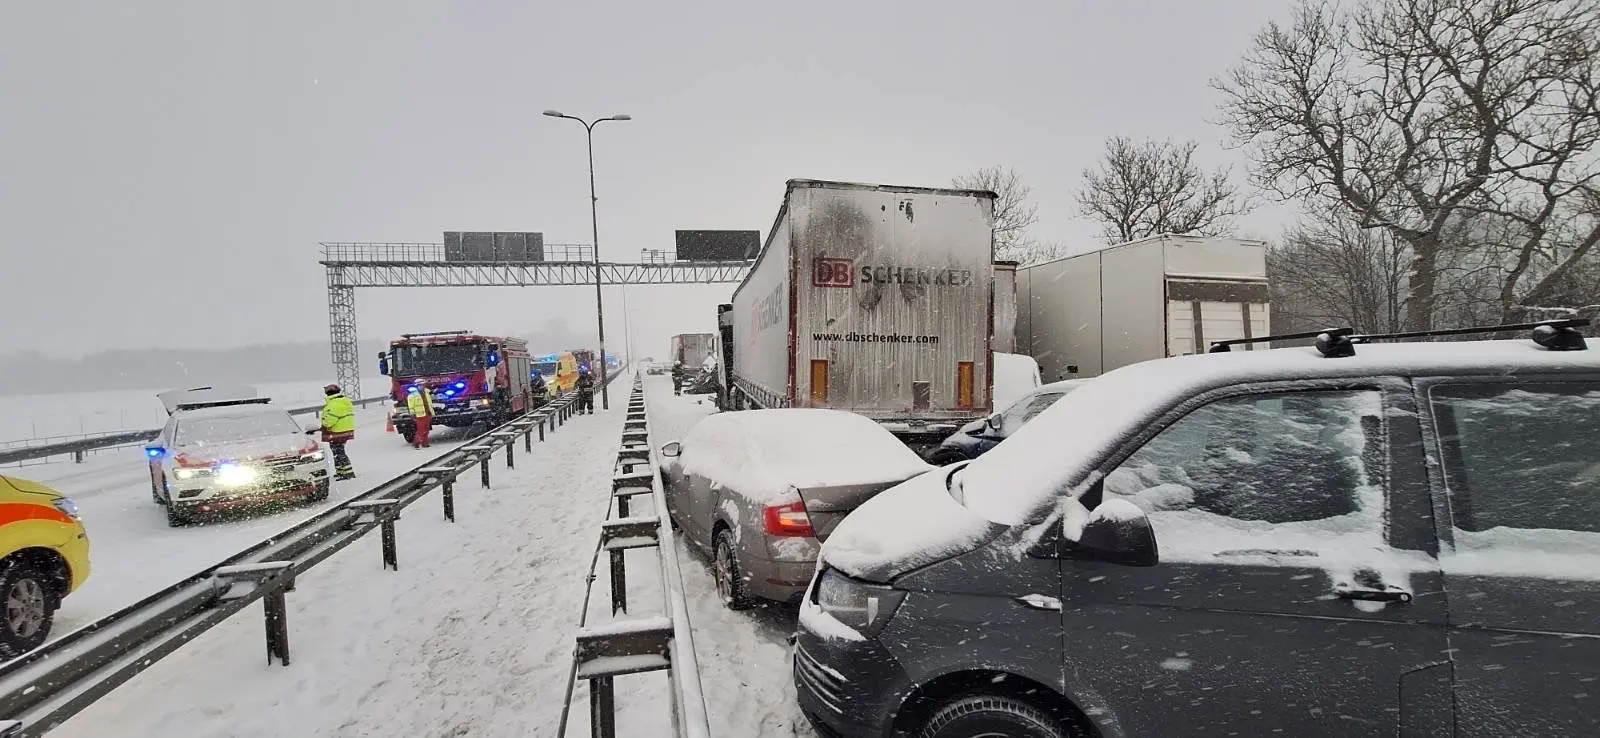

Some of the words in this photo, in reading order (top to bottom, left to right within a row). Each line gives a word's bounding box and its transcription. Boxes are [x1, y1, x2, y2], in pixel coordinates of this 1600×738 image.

[816, 261, 850, 284] DB
[861, 265, 972, 286] SCHENKER
[813, 331, 939, 344] www.dbschenker.com
